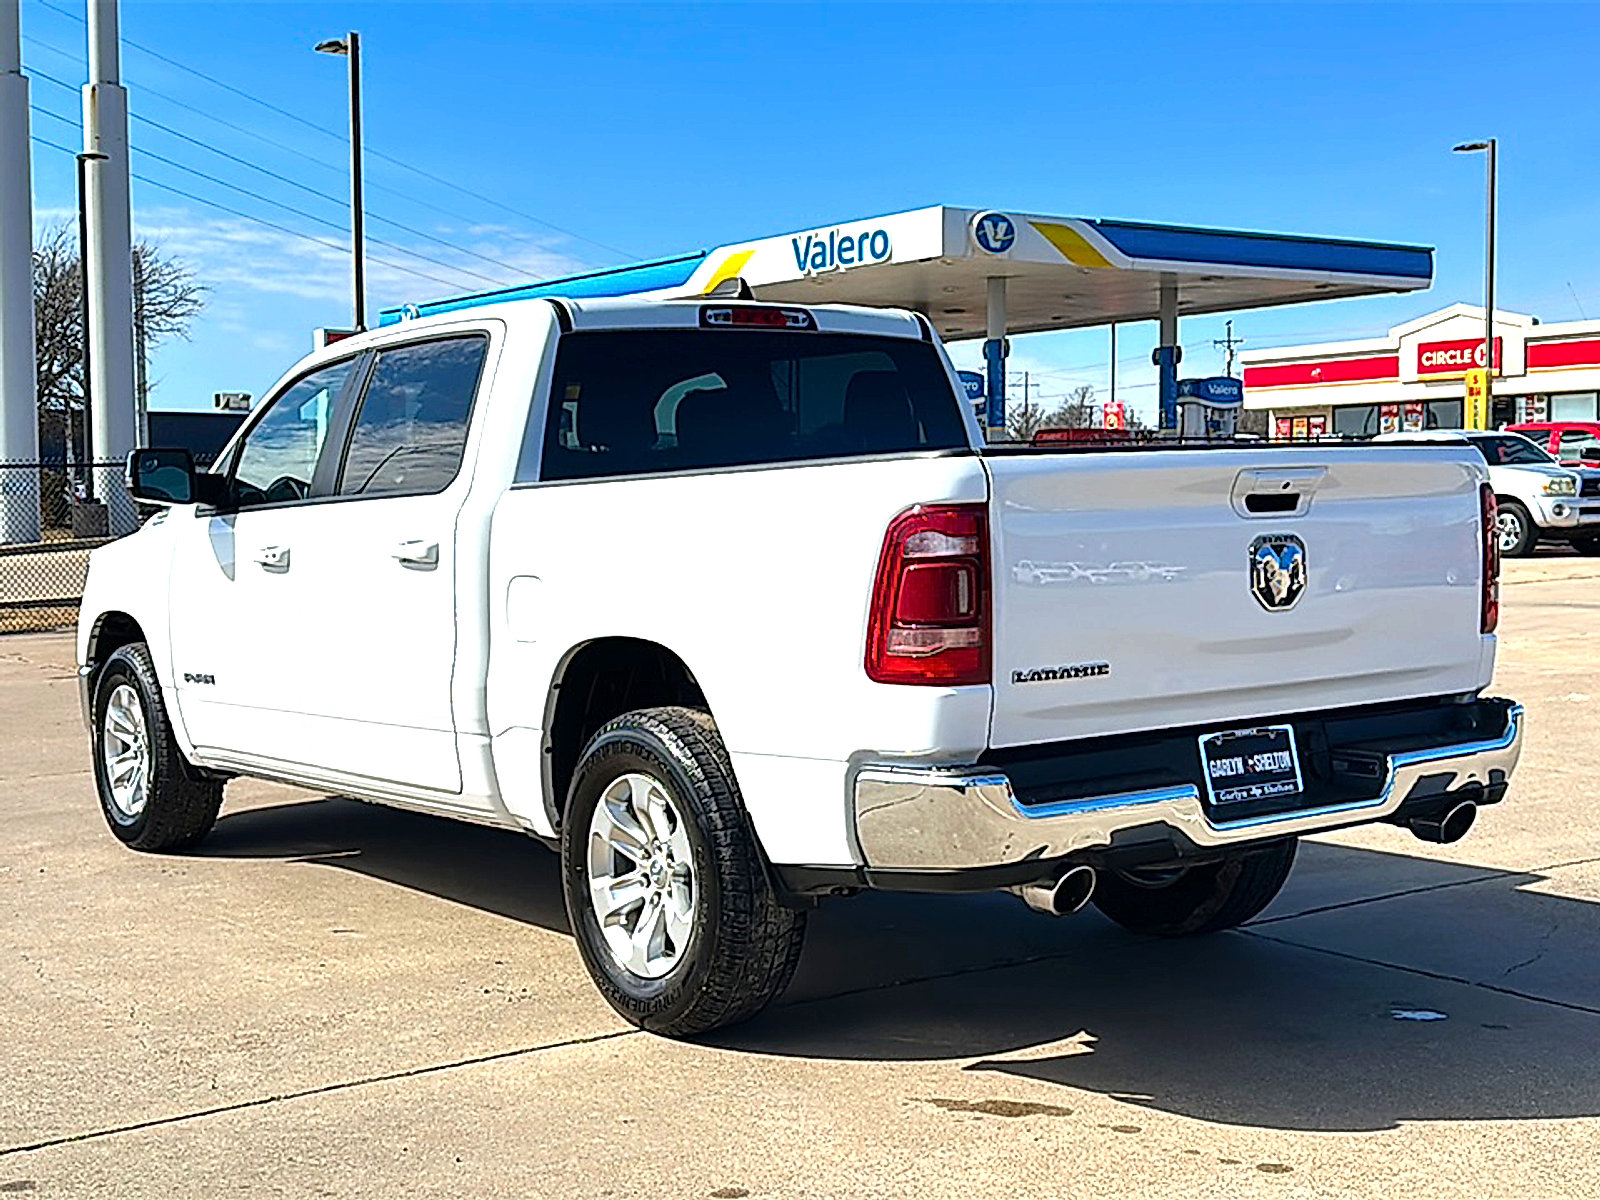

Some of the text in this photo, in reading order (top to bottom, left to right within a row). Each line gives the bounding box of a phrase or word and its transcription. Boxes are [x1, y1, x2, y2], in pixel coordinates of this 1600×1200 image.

[792, 229, 890, 273] Valero
[1421, 349, 1472, 367] CIRCLE
[1207, 384, 1238, 395] Valero
[1012, 663, 1110, 684] LARAMIE
